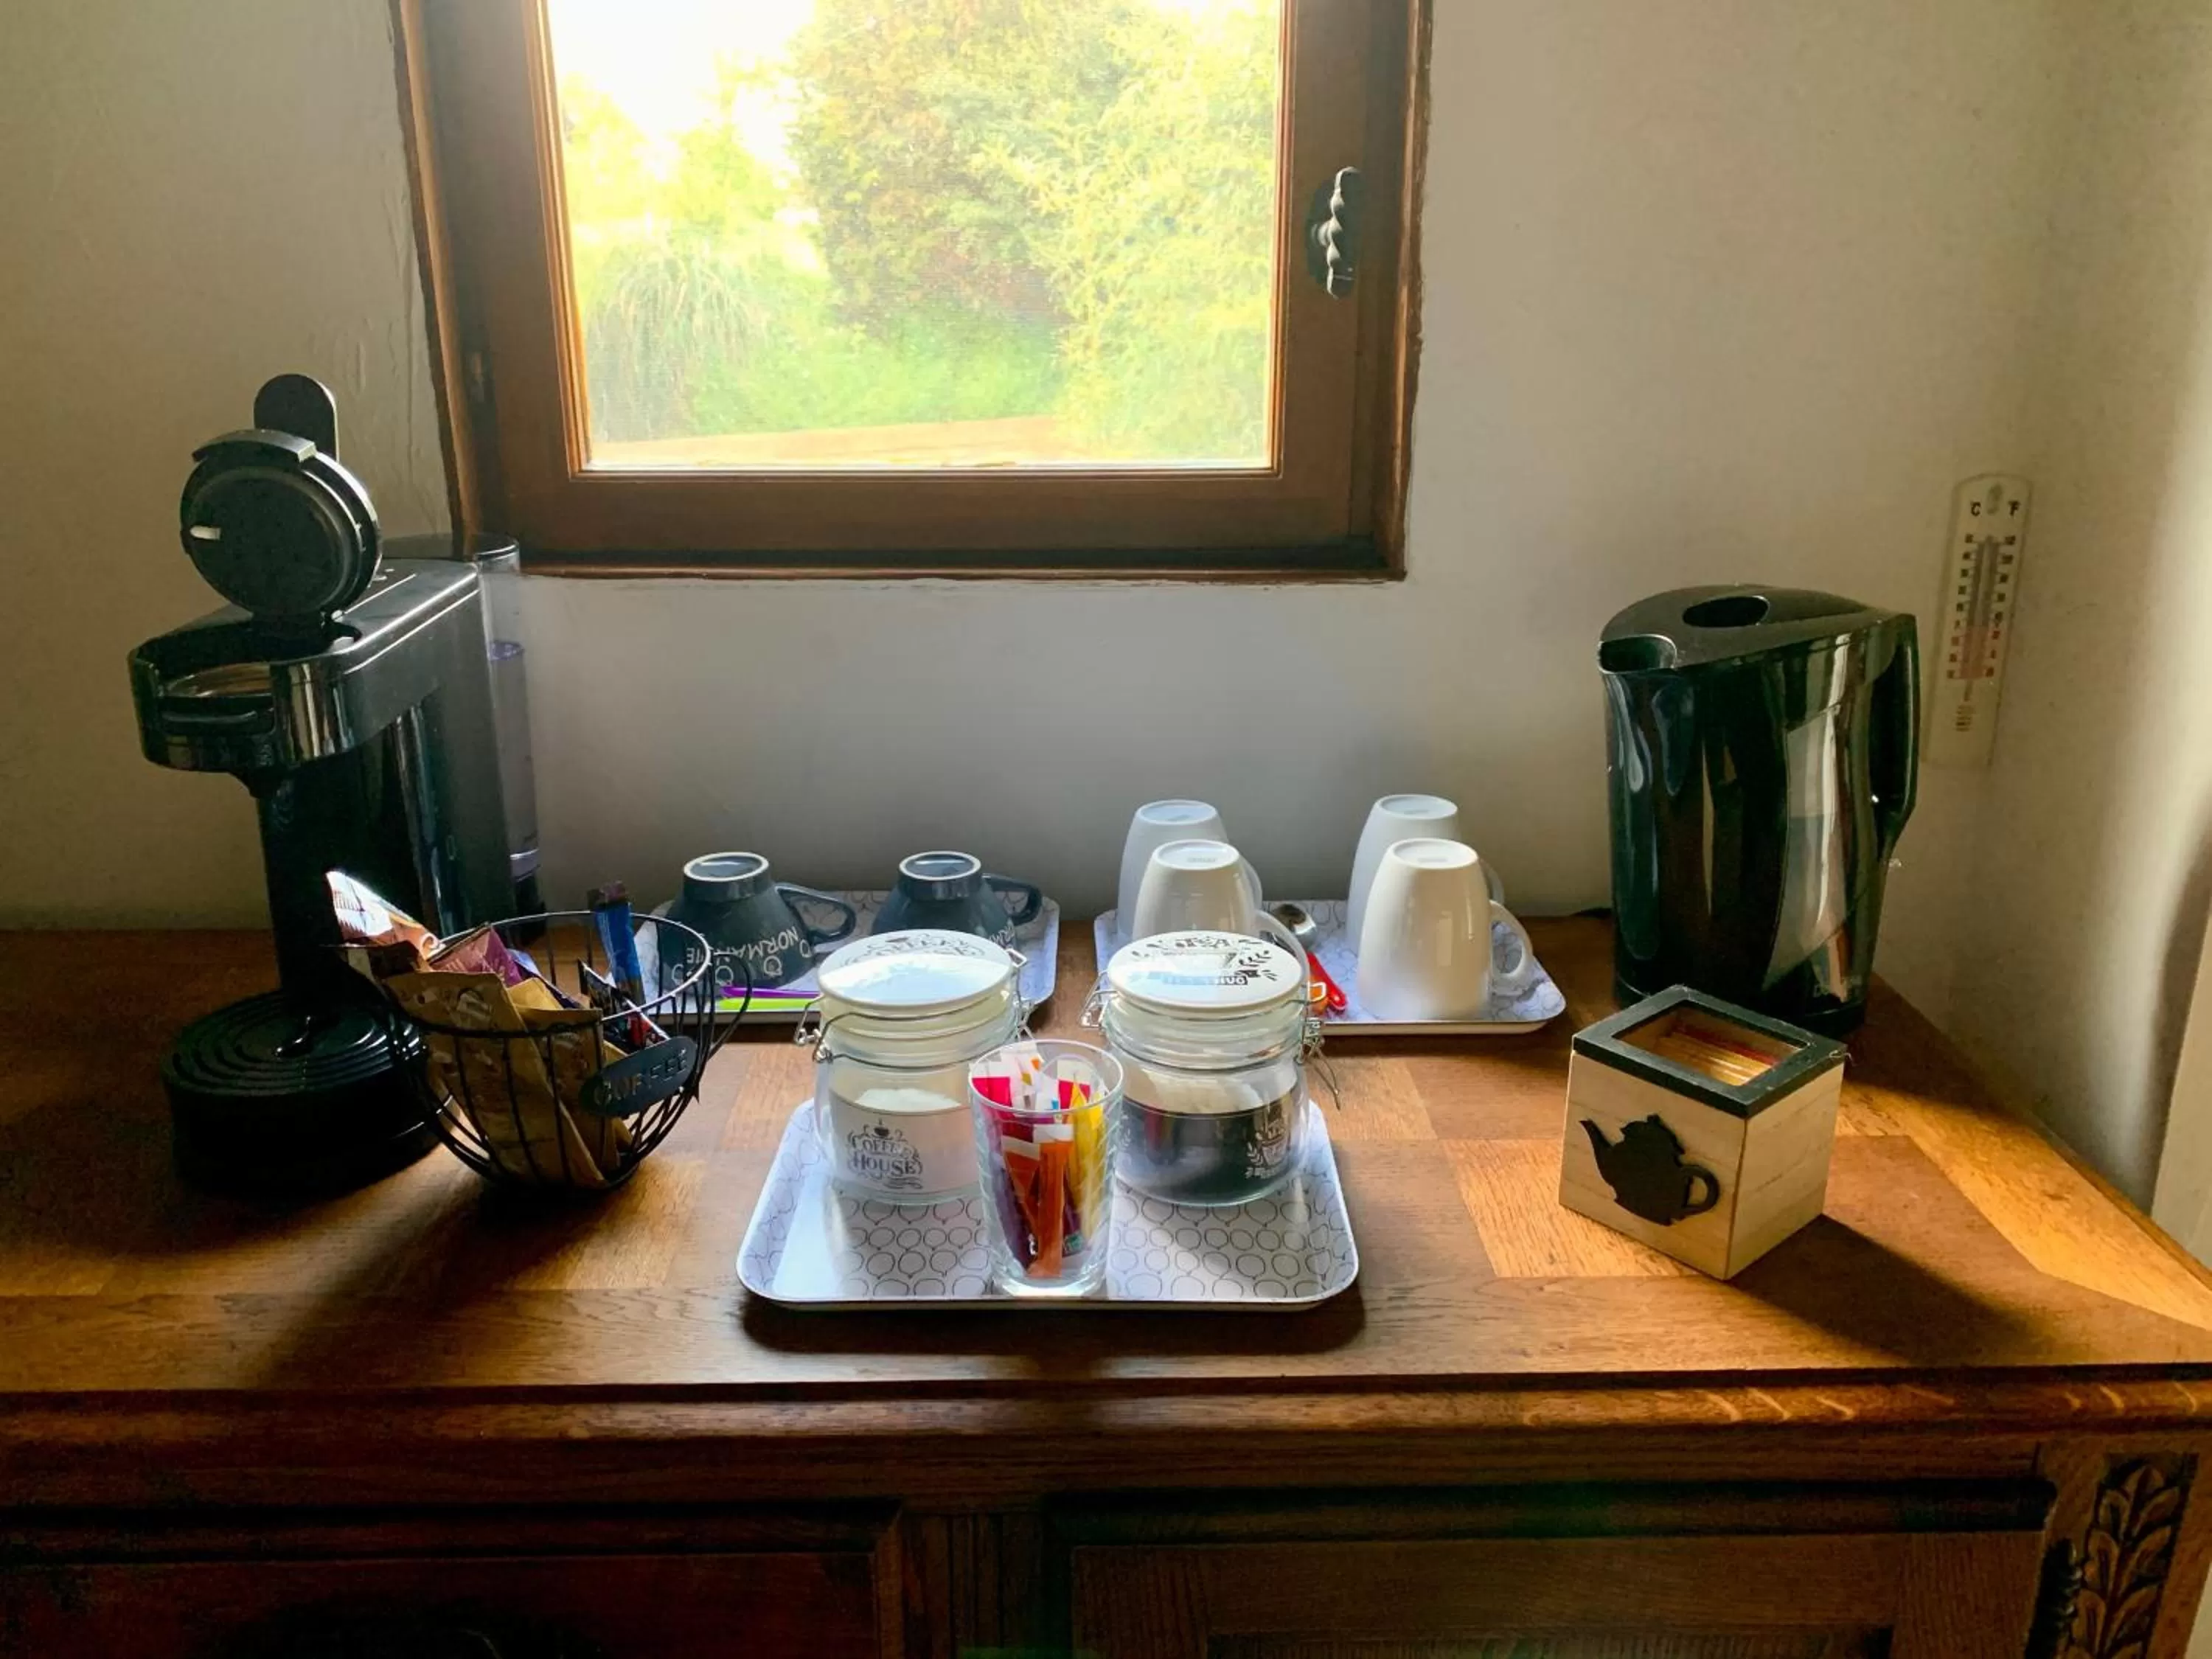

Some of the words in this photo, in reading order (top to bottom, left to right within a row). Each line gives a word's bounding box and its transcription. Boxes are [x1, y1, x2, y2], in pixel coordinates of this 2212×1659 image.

[1970, 501, 1981, 517] C
[2008, 501, 2020, 517] F
[593, 1047, 689, 1105] COFFEE
[852, 1150, 917, 1178] HOUSE
